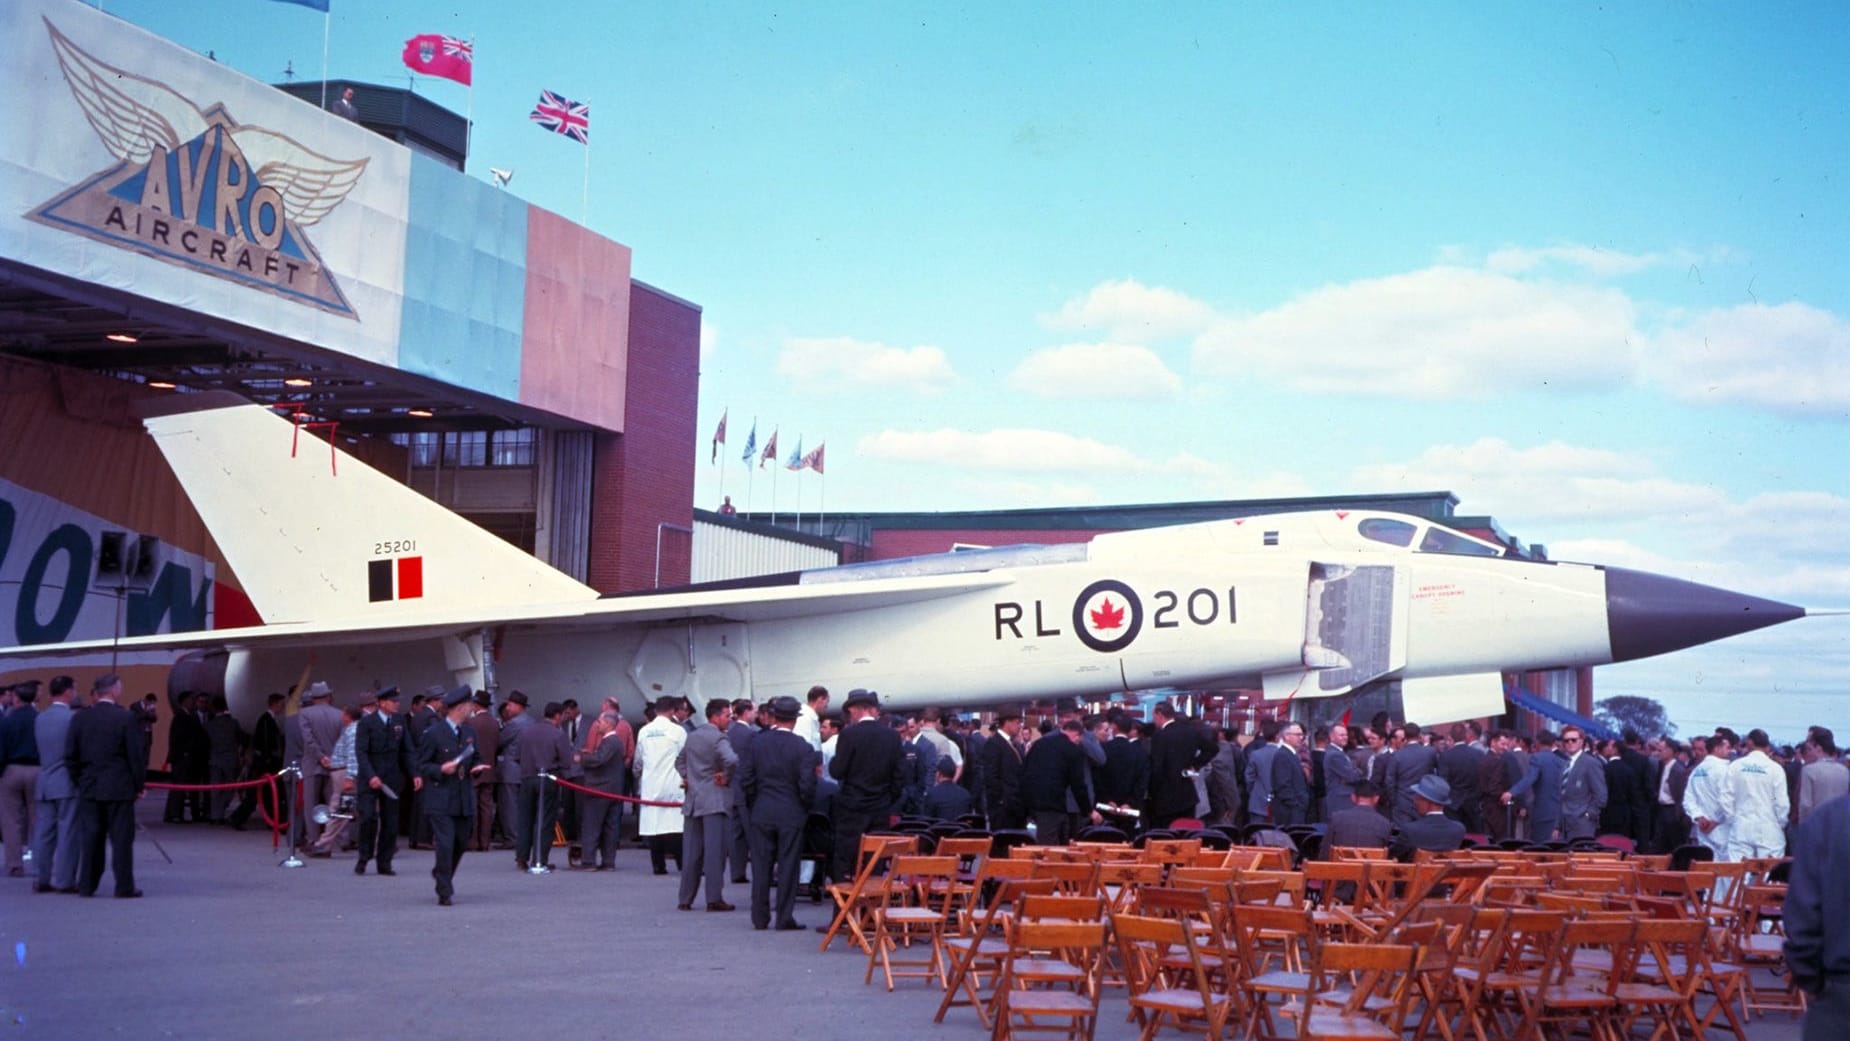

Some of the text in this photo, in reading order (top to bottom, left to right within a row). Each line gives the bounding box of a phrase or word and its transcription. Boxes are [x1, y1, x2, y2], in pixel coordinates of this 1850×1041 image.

[139, 121, 286, 250] AVRO
[105, 205, 300, 284] AIRCRAFT
[374, 540, 416, 554] 25201
[994, 585, 1237, 640] RL 201
